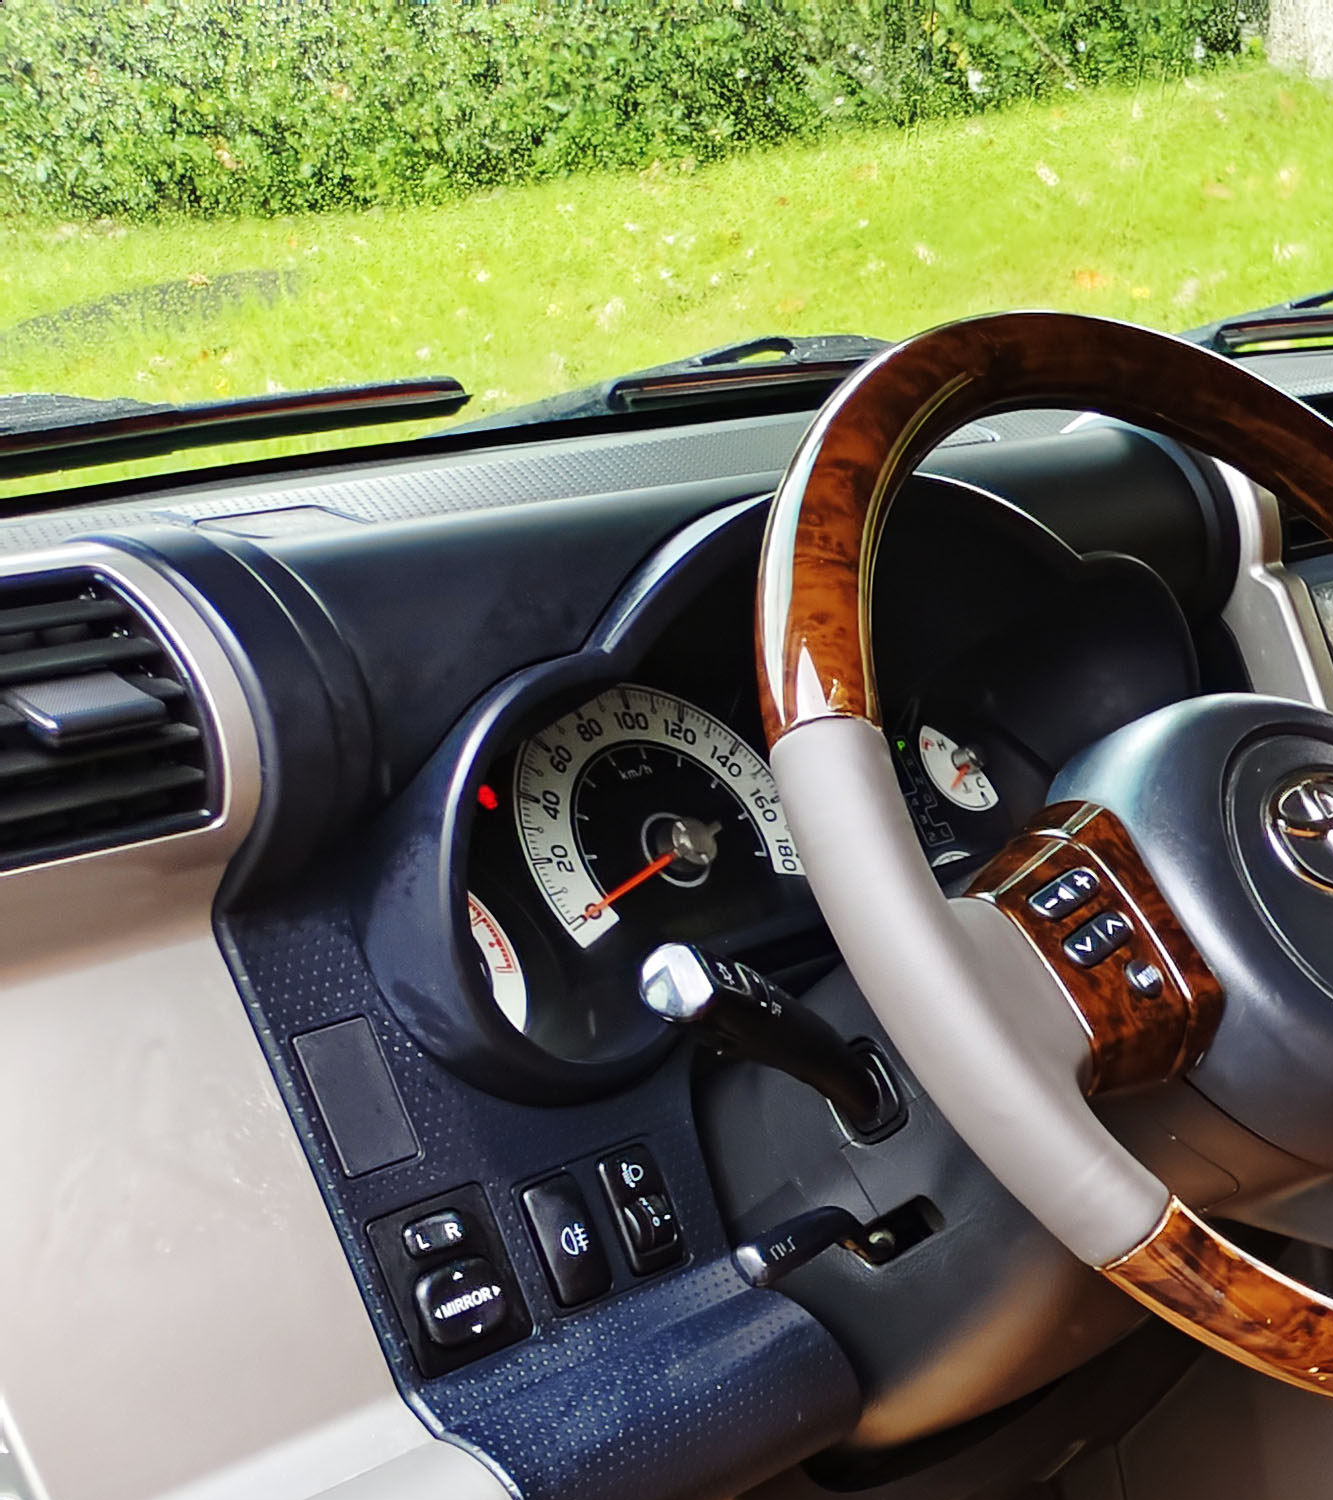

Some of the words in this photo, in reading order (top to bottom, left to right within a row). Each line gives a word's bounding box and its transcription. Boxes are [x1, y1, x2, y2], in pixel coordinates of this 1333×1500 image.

[576, 718, 604, 742] 80
[613, 711, 649, 731] 100
[663, 718, 697, 746] 120
[937, 738, 947, 751] H
[550, 745, 573, 774] 60
[618, 766, 653, 781] km/h
[709, 745, 742, 778] 140
[976, 777, 986, 789] C
[542, 790, 562, 820] 40
[749, 788, 778, 823] 160
[550, 844, 575, 874] 20
[775, 838, 797, 872] 180
[417, 1233, 431, 1250] L
[444, 1221, 463, 1241] R
[440, 1286, 492, 1320] MIRROR
